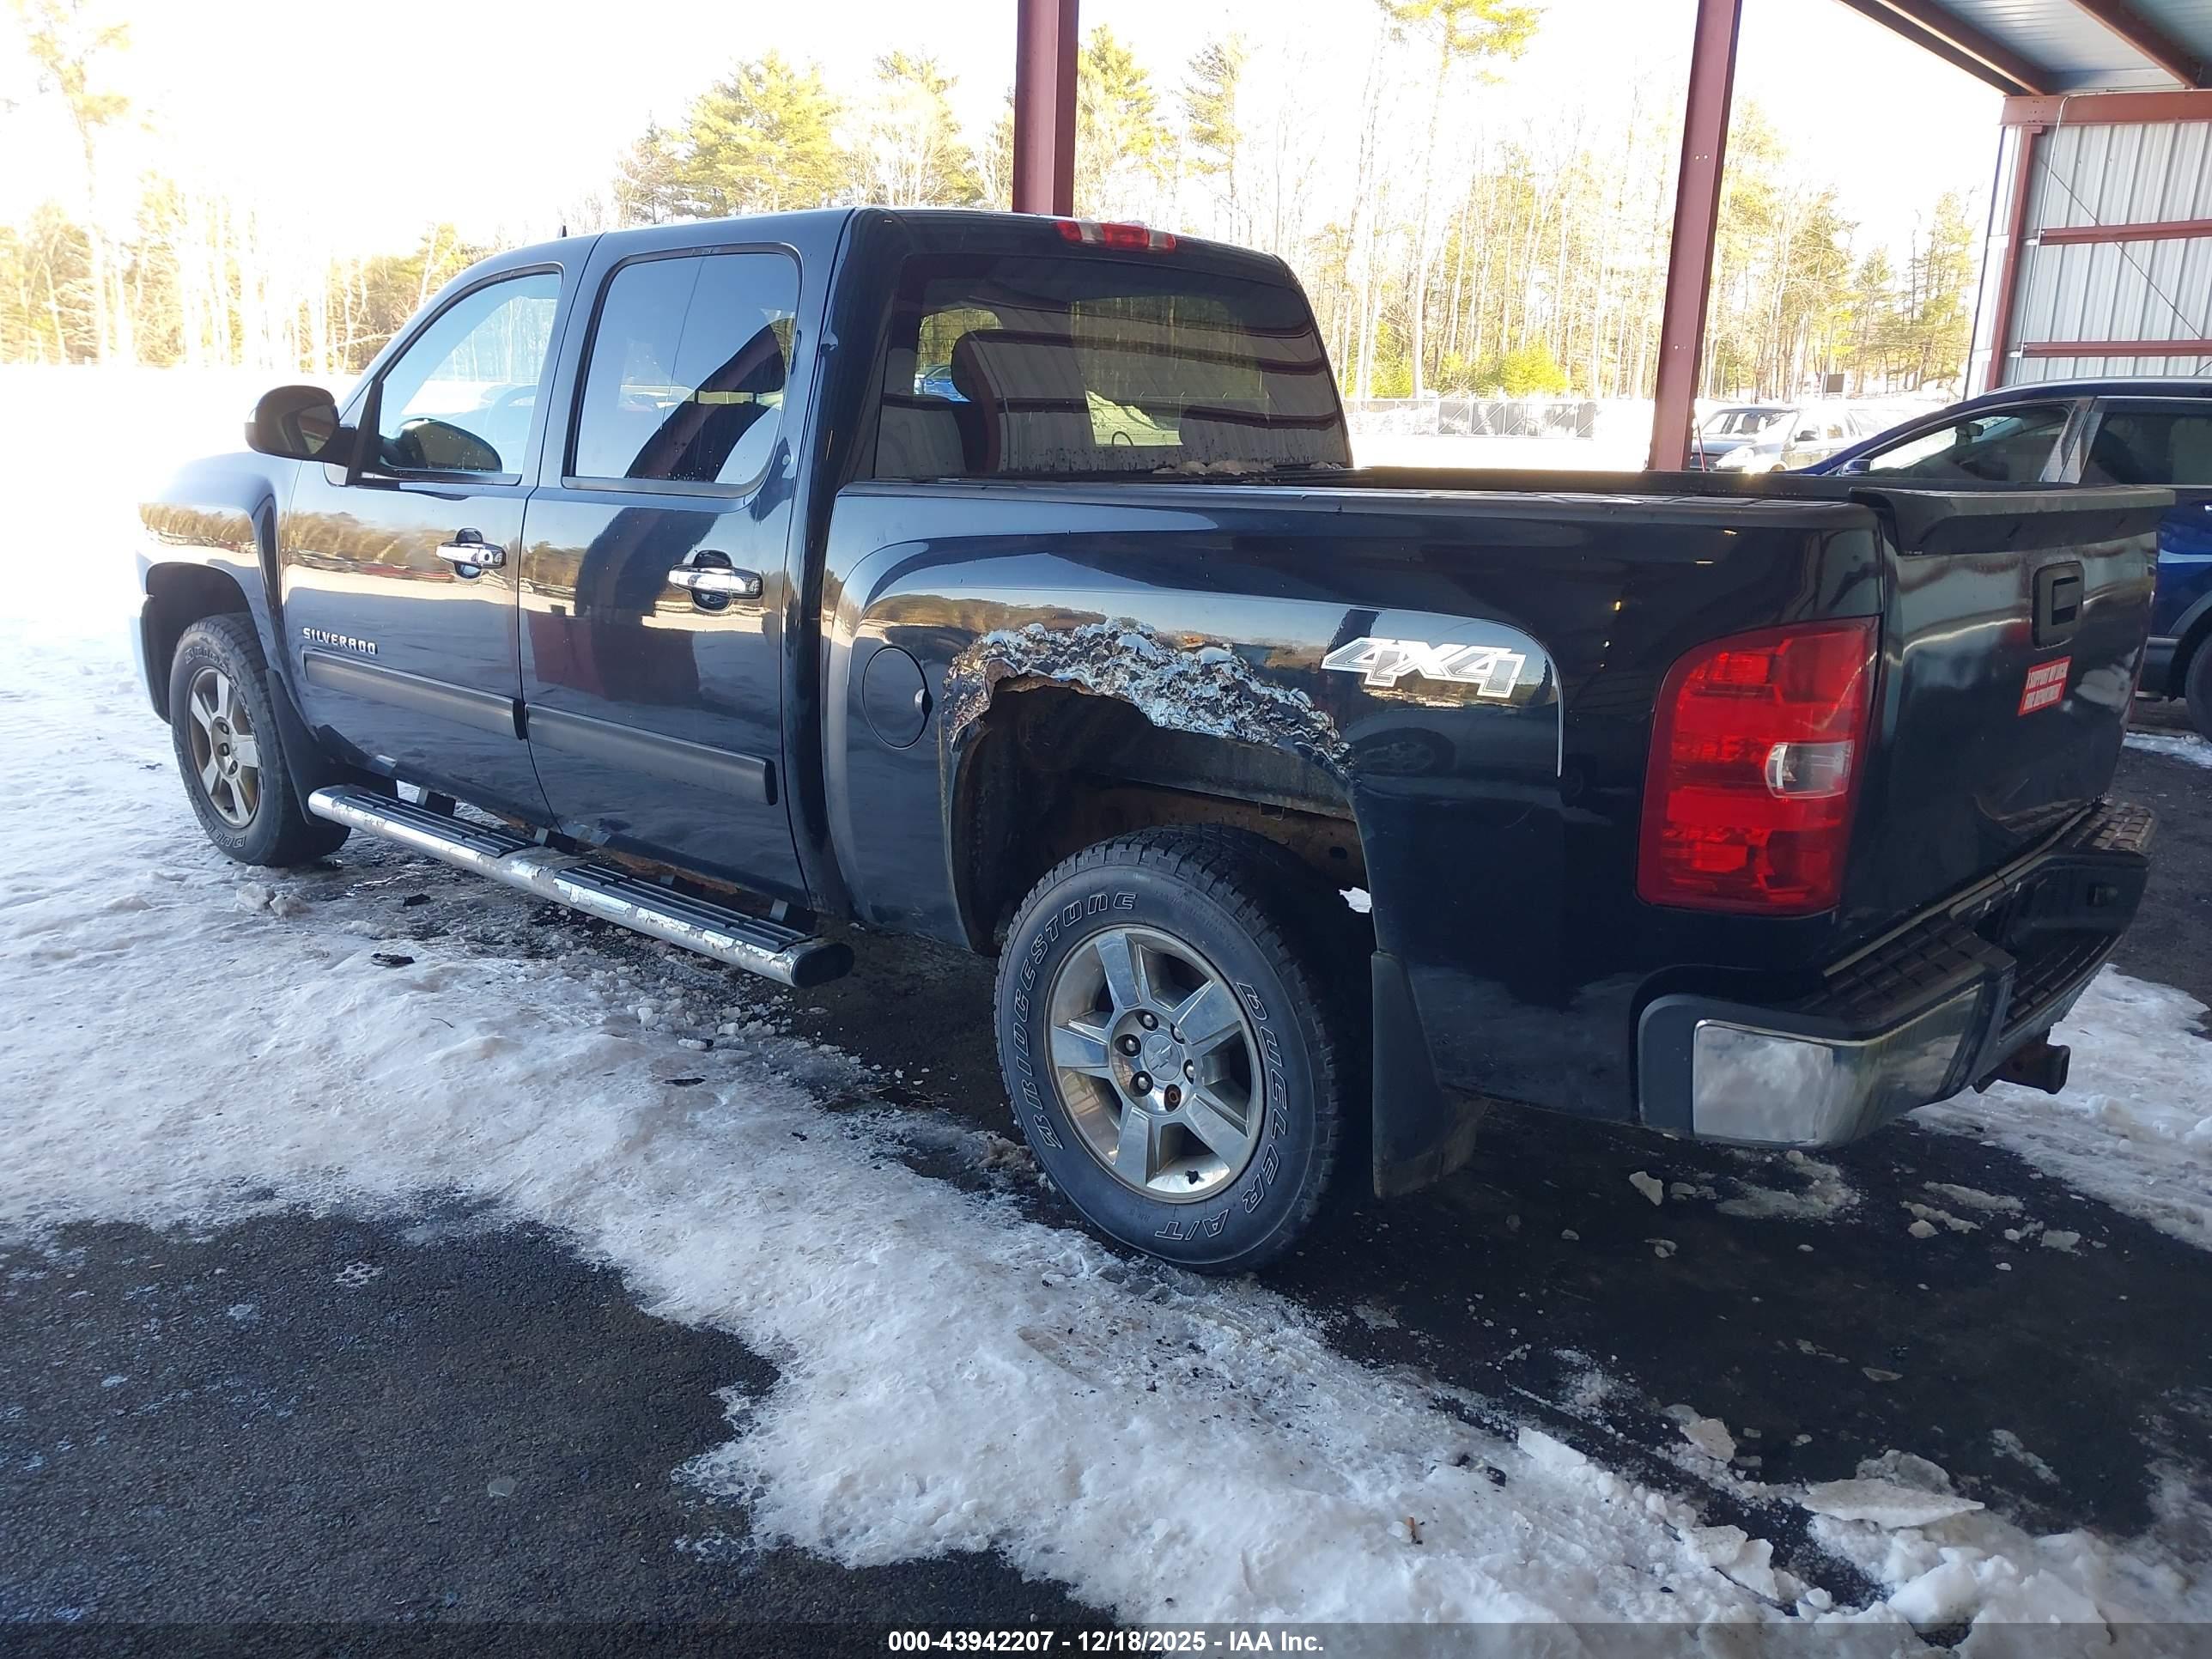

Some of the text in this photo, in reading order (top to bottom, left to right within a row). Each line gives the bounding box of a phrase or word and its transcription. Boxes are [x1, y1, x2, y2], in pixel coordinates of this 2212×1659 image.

[303, 627, 377, 654] SILVERADO
[1321, 637, 1526, 698] 4X4
[1011, 890, 1138, 1150] BRIDGESTONE
[1155, 981, 1288, 1241] DUELER A/T
